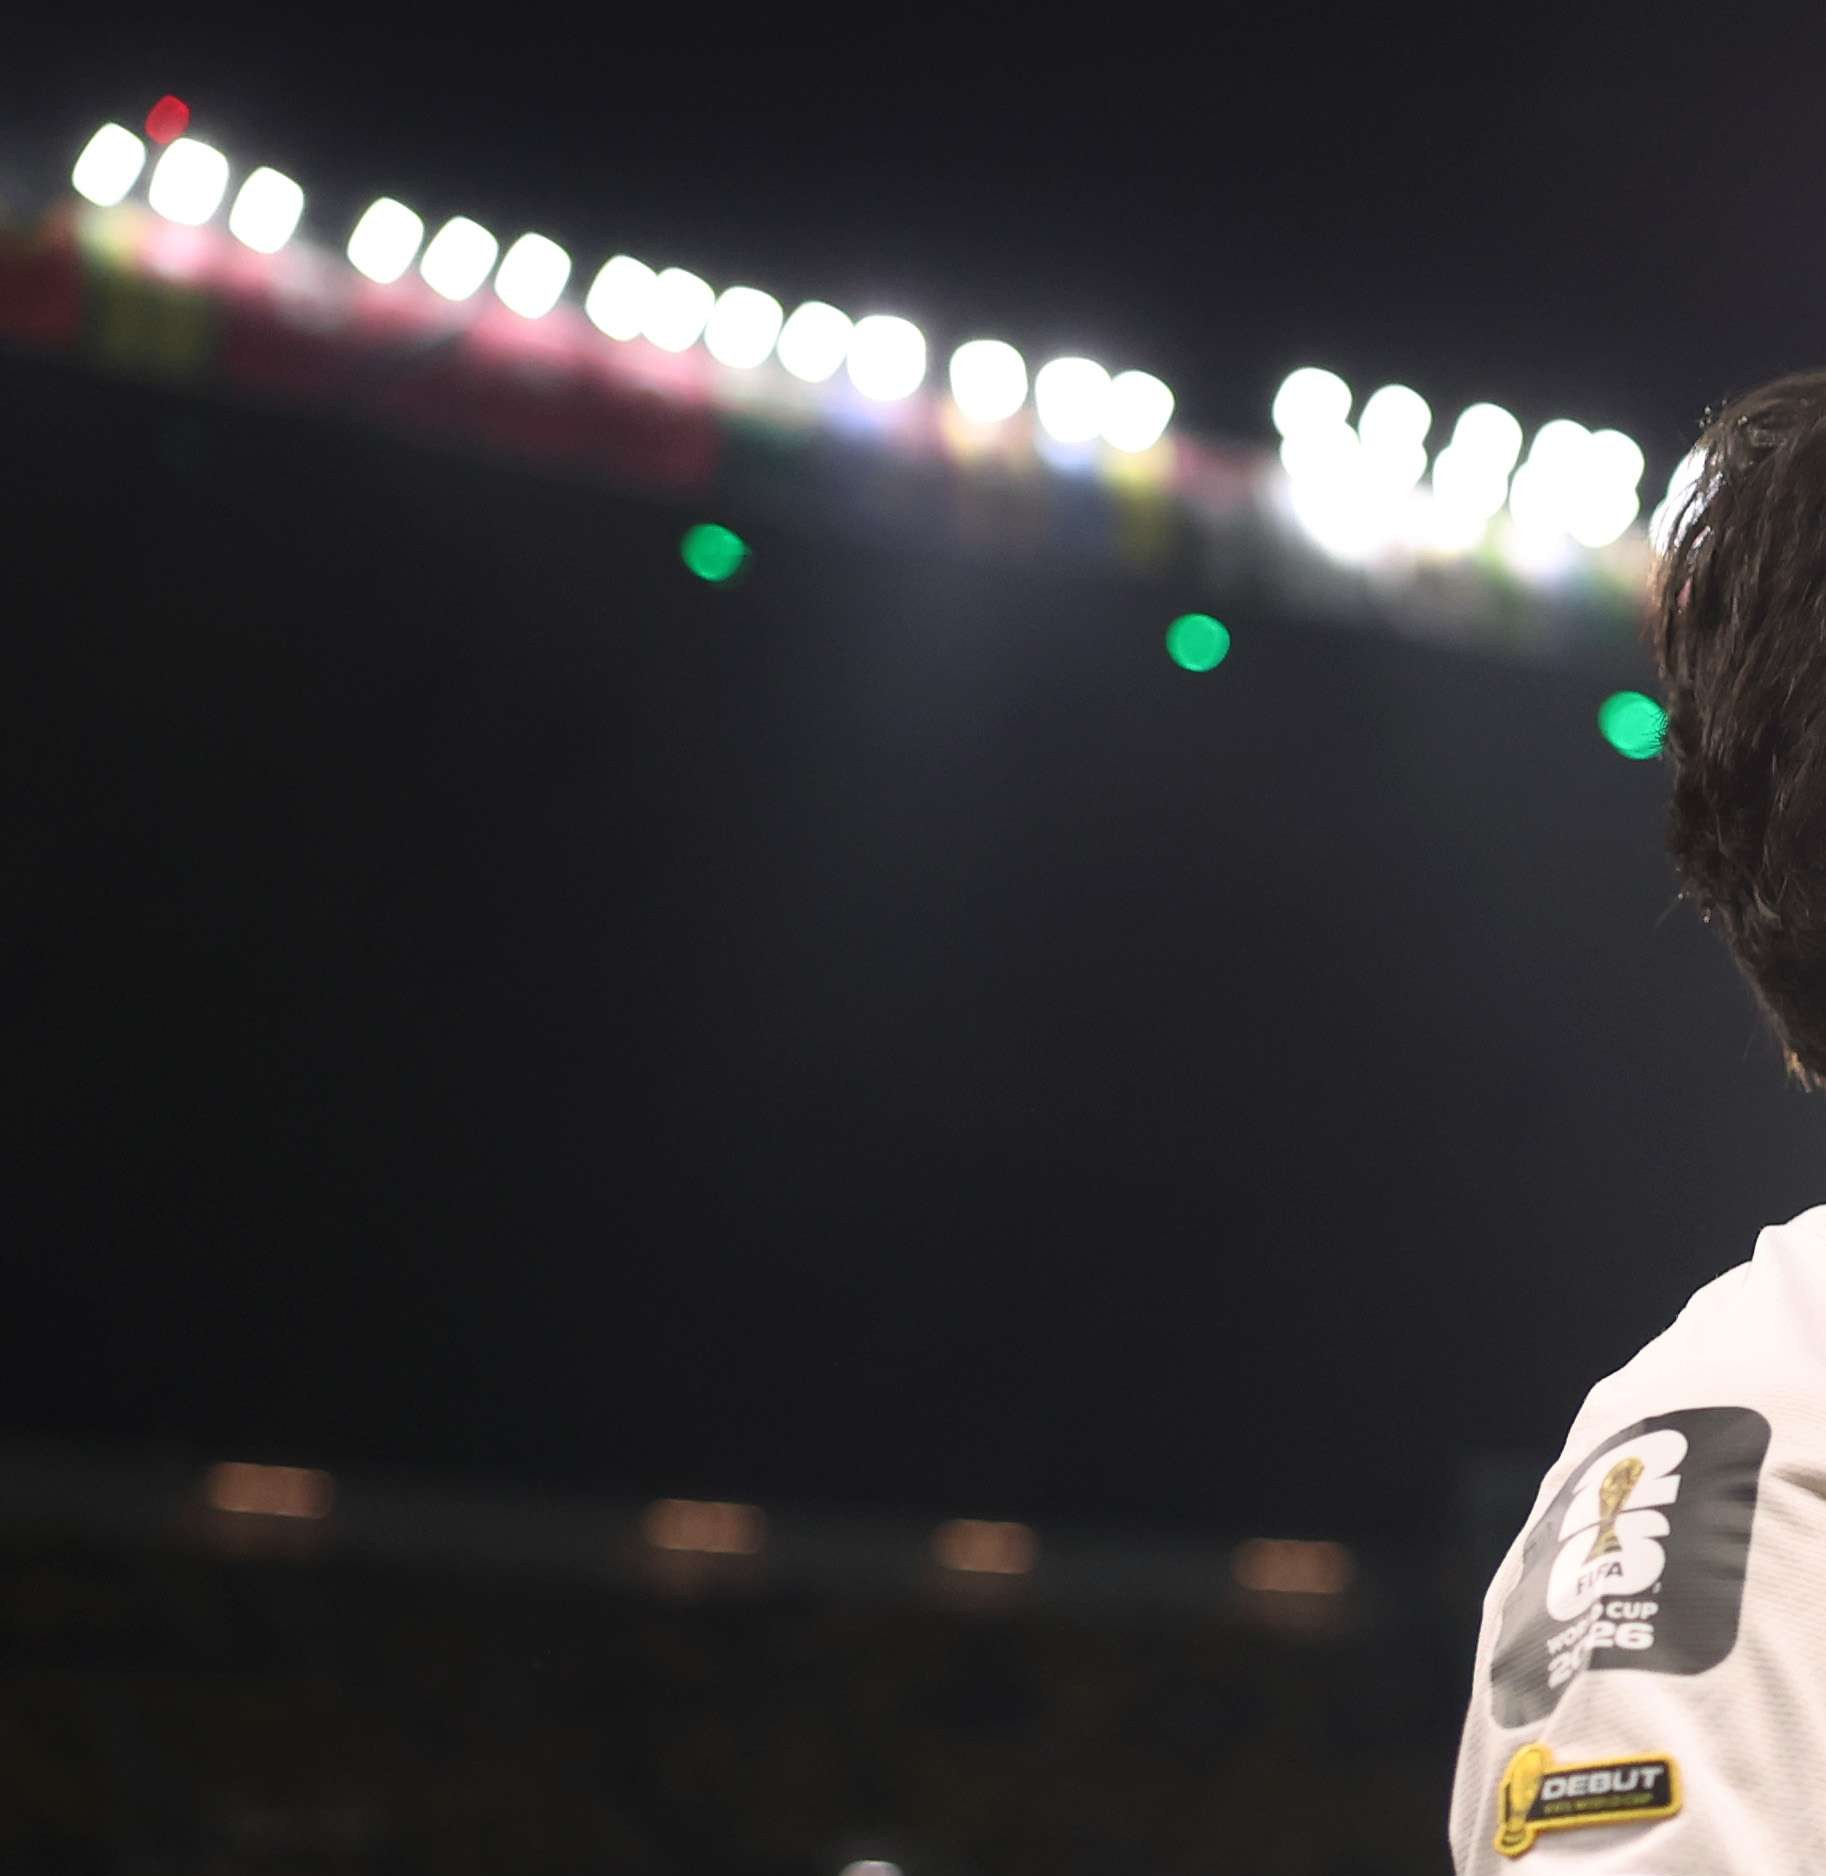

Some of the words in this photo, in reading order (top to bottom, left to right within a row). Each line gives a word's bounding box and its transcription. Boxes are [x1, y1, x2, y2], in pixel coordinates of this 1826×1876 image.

[1577, 1561, 1624, 1596] FIFA
[1605, 1600, 1659, 1619] CUP
[1541, 1766, 1664, 1800] DEBUT
